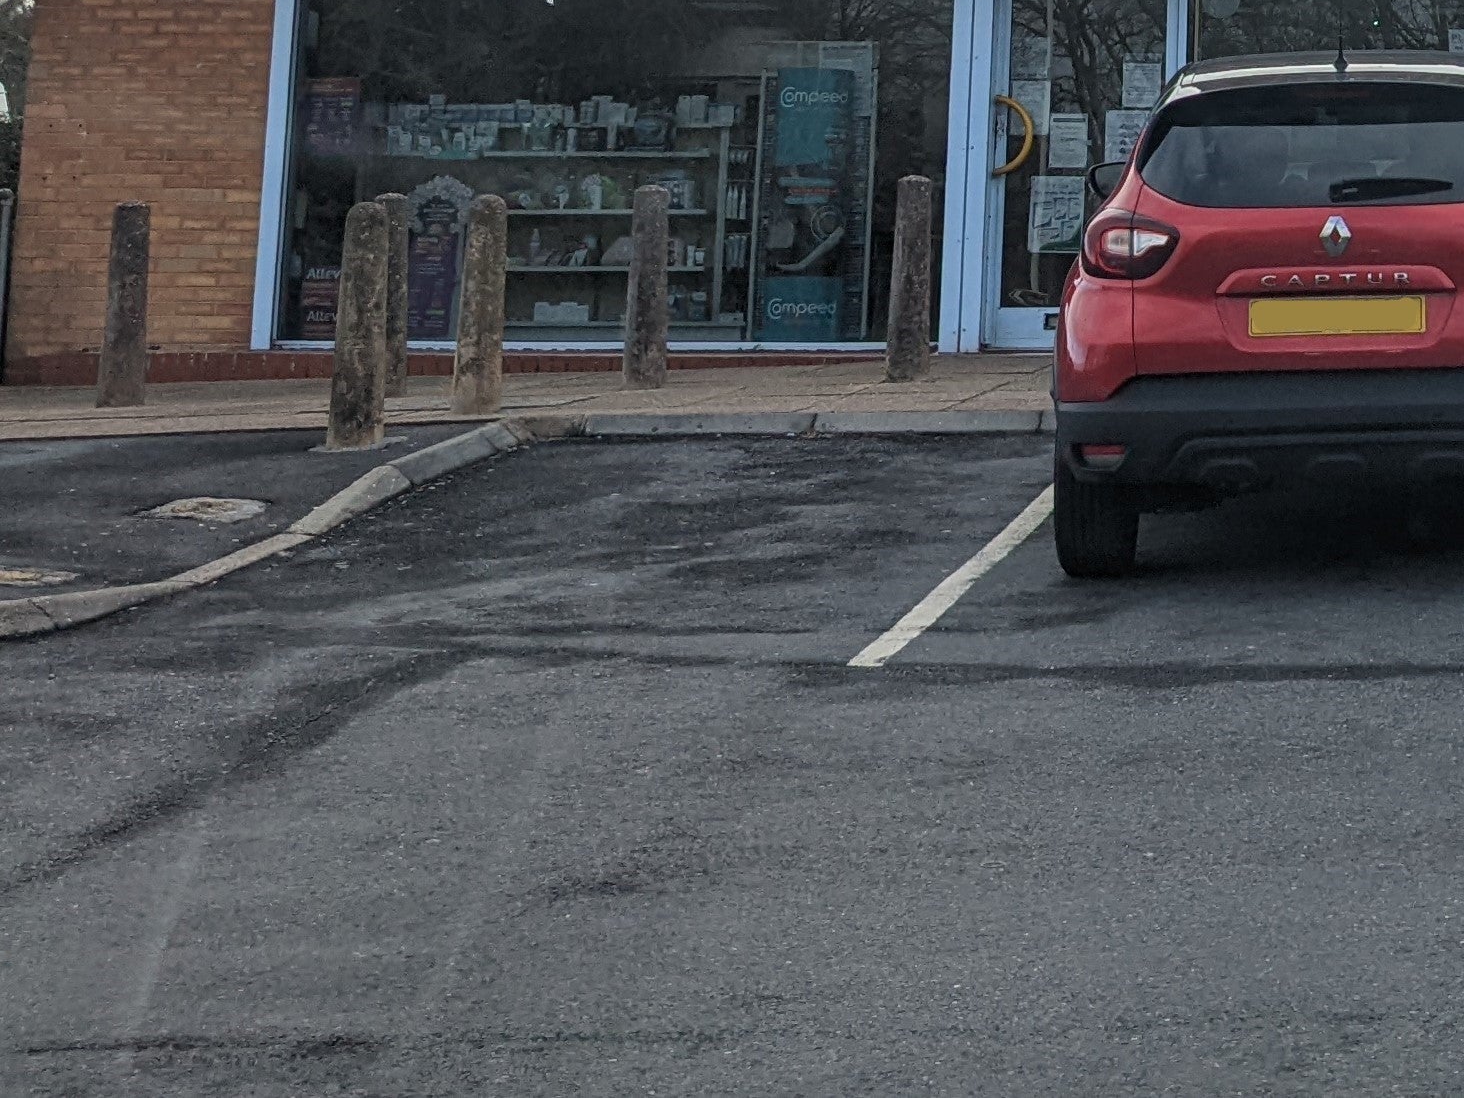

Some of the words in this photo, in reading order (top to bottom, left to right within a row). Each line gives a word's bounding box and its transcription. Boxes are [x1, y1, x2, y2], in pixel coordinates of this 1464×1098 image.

[780, 86, 848, 108] Compeed
[1260, 272, 1410, 287] CAPTUR
[767, 298, 837, 320] Compeed
